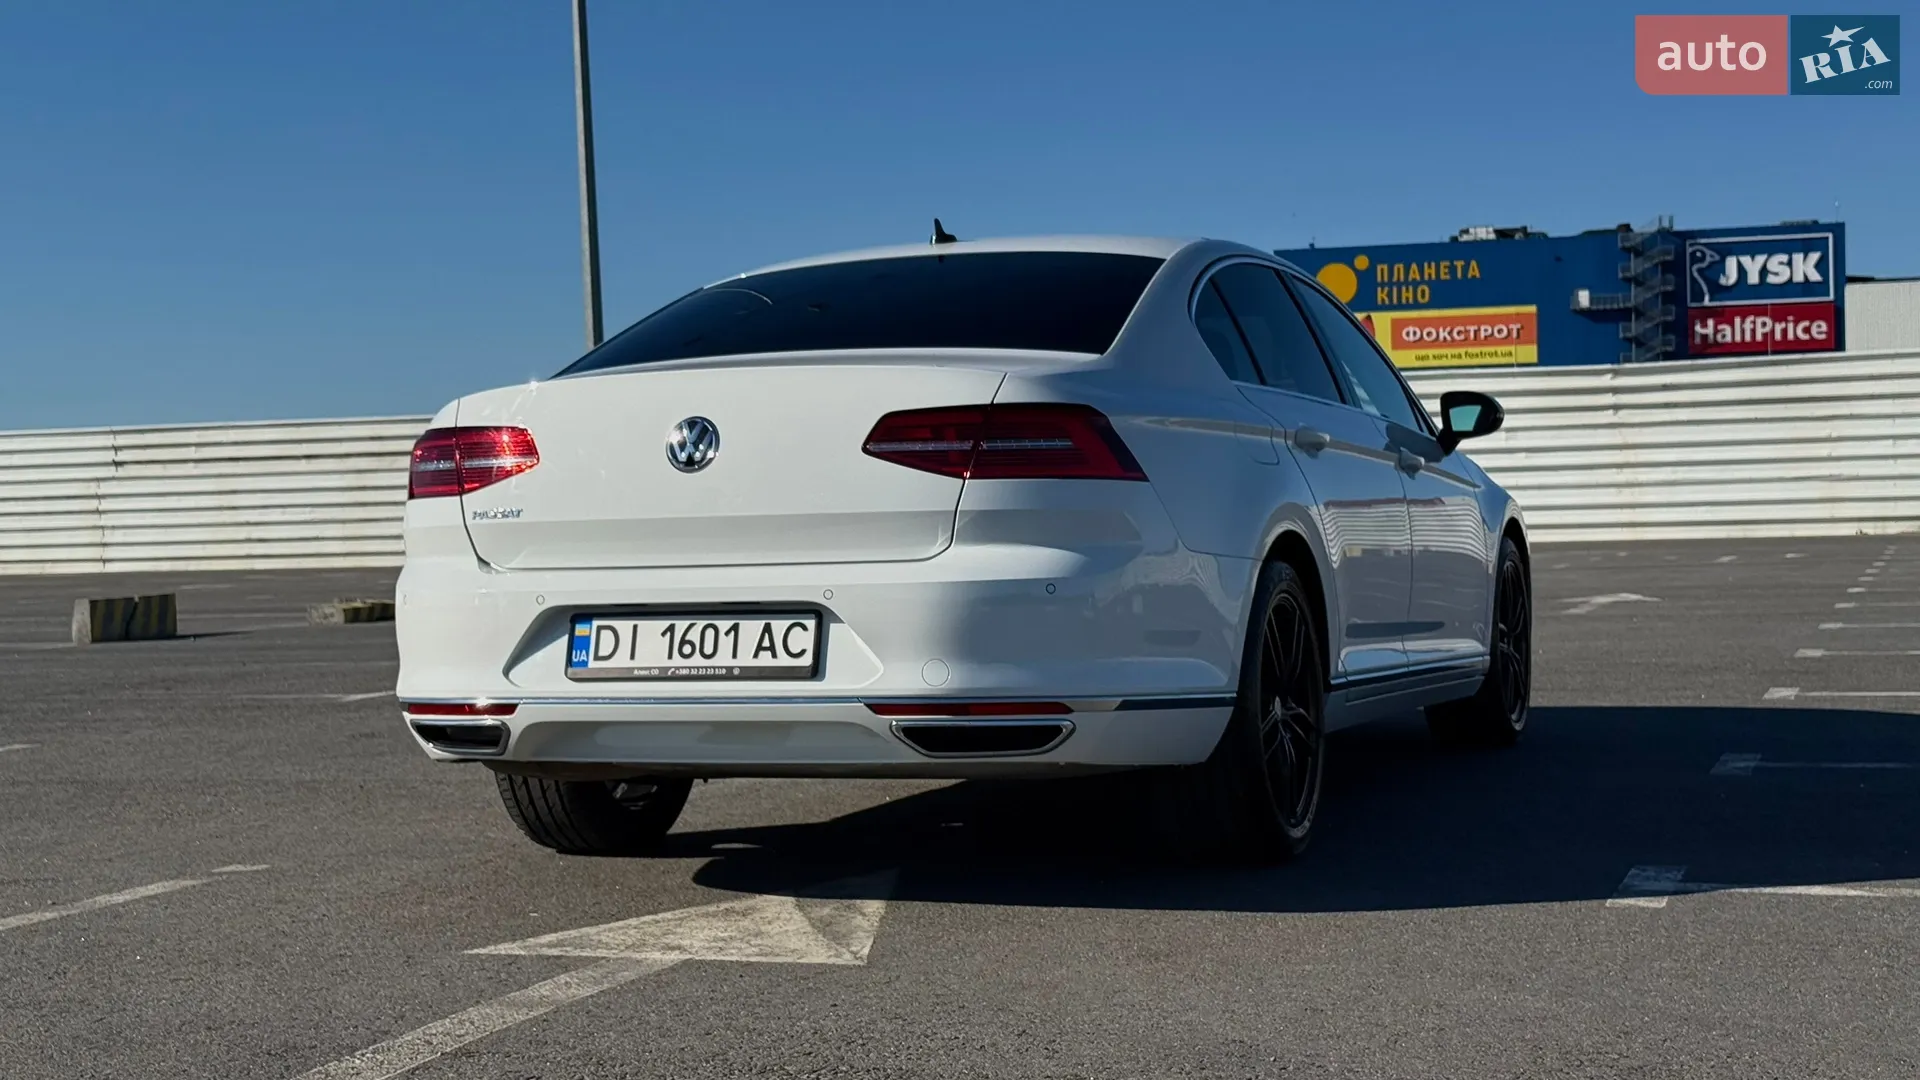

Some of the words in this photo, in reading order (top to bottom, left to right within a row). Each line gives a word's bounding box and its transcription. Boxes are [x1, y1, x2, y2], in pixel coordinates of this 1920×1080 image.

[1376, 260, 1481, 283] ПЛАНЕТА
[1718, 251, 1824, 287] JYSK
[1376, 285, 1430, 305] КІНО
[1401, 323, 1522, 343] ФОКСТРОТ
[1694, 314, 1829, 345] HalfPrice
[1464, 349, 1513, 360] foxtrot.ua
[592, 623, 638, 662] DI
[660, 621, 741, 661] 1601
[752, 621, 809, 660] AC
[572, 649, 588, 663] UA
